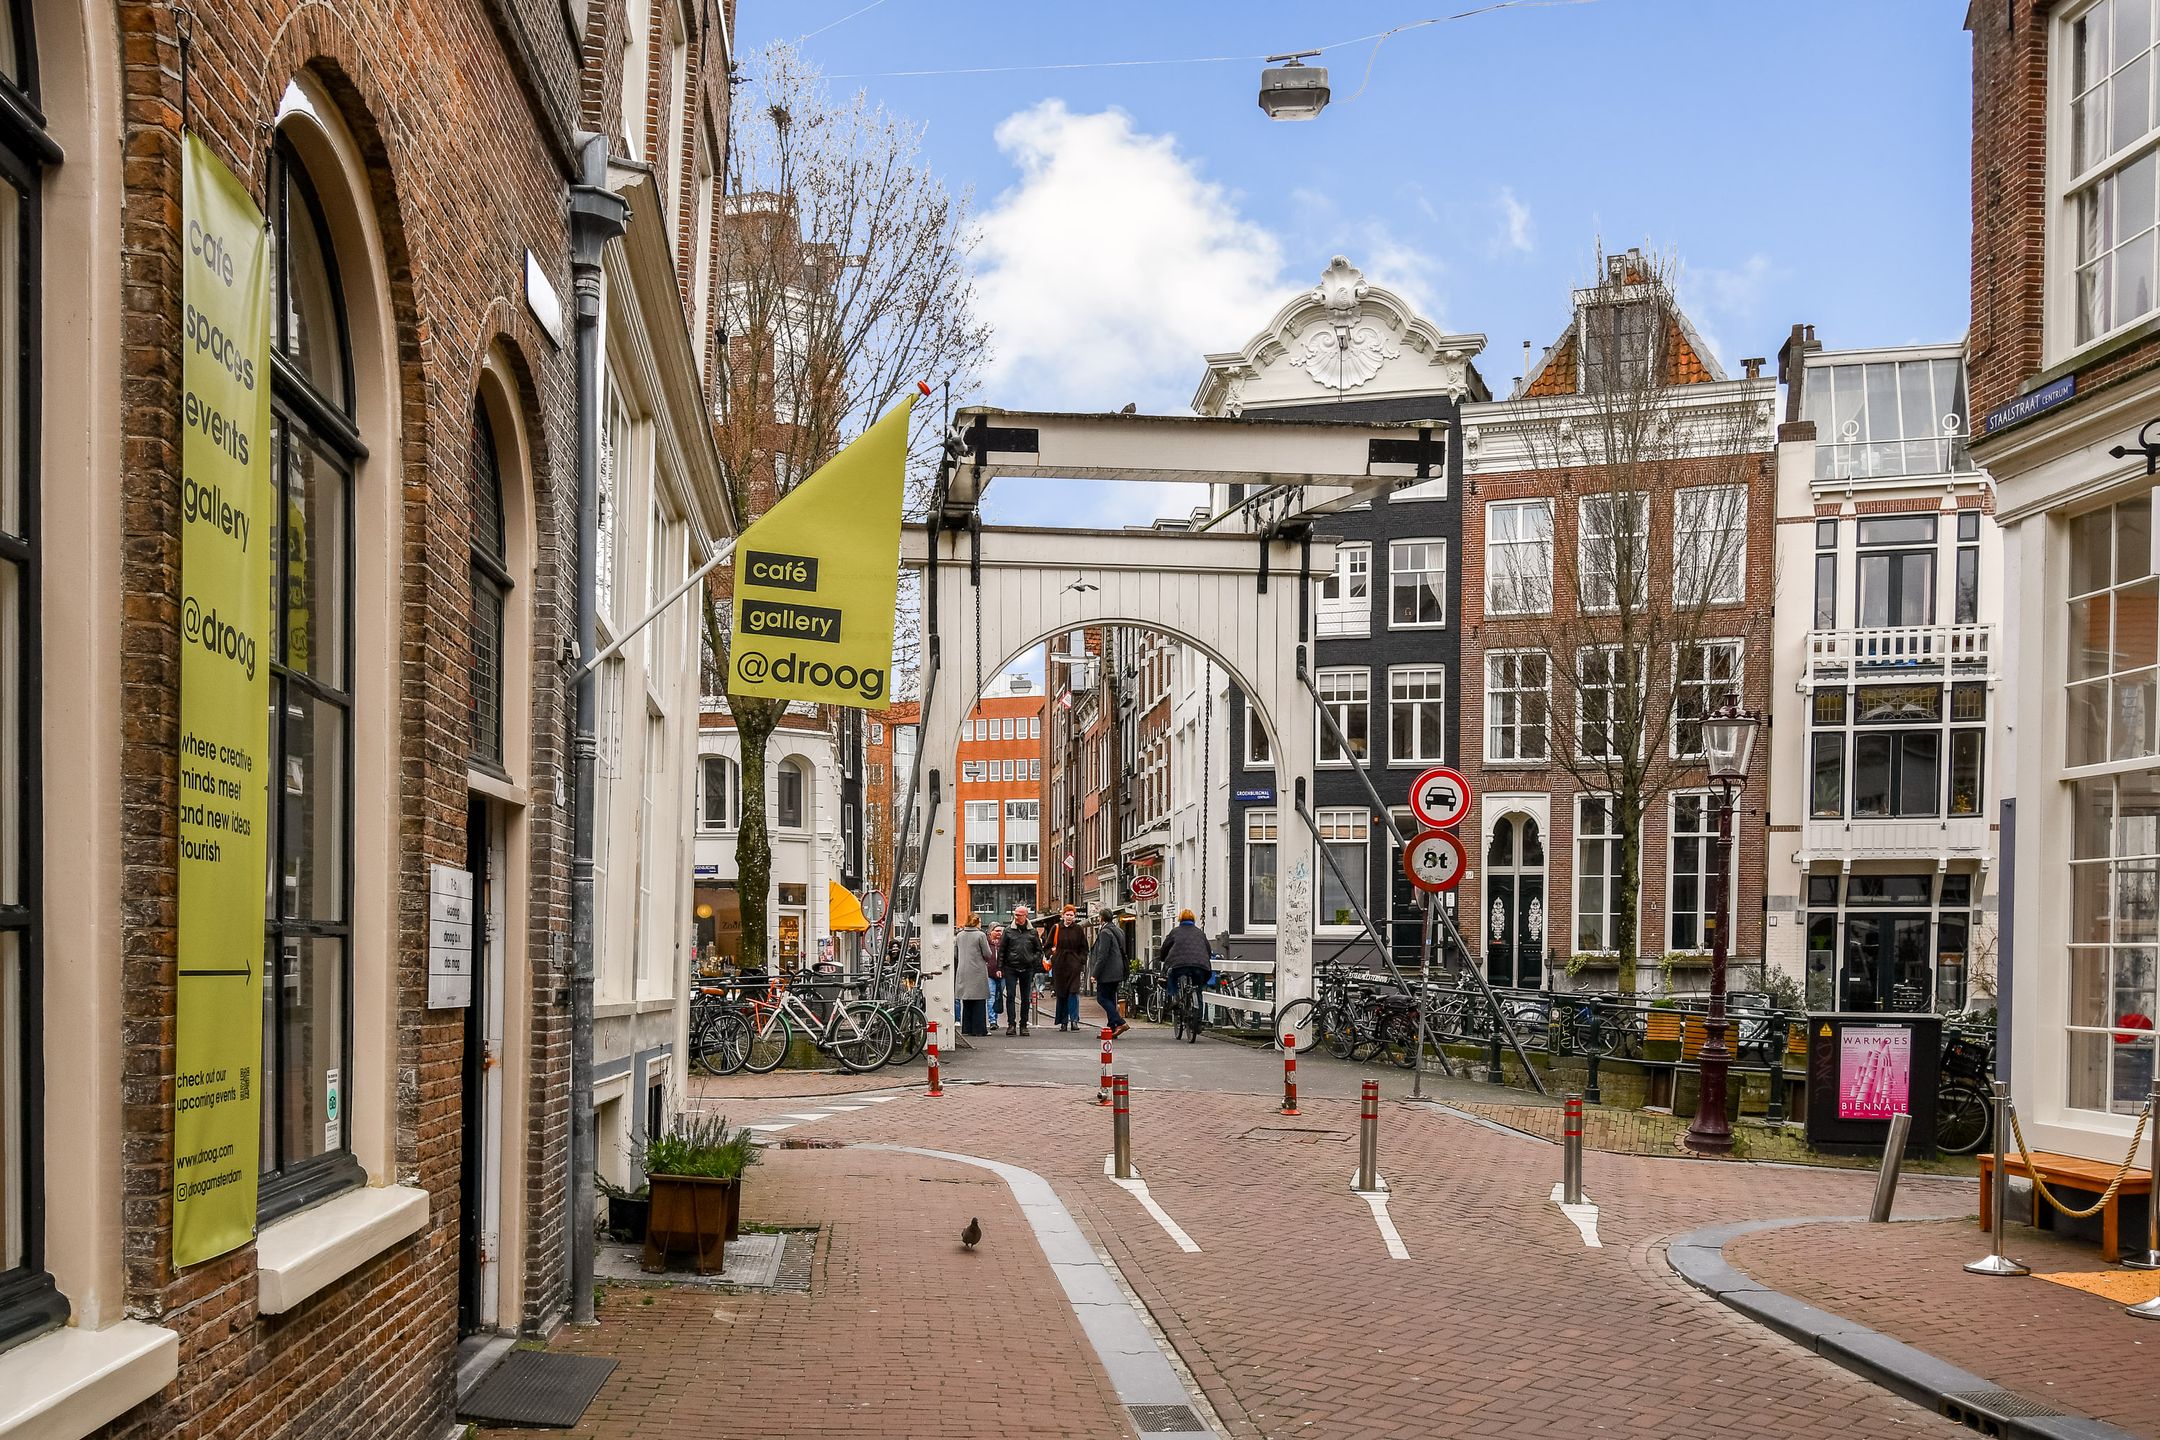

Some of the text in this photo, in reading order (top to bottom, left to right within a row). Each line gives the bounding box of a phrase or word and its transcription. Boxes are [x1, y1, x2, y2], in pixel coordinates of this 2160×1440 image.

[187, 303, 254, 391] spaces
[1989, 387, 2069, 431] STAALSTRAAT CENTRUM
[185, 391, 249, 466] events
[184, 477, 250, 553] gallery
[752, 561, 808, 583] café
[749, 609, 834, 637] gallery
[183, 596, 256, 682] @droog
[737, 651, 884, 700] @droog
[219, 745, 252, 773] creative
[218, 777, 242, 801] meet
[206, 810, 230, 830] new
[231, 811, 251, 836] ideas
[1423, 851, 1449, 869] 8t
[1843, 1037, 1908, 1045] WARMOES
[176, 1068, 227, 1089] check out our
[176, 1086, 236, 1114] upcoming events
[1841, 1102, 1907, 1111] BIENNALE
[176, 1143, 234, 1170] www.droog.com
[187, 1169, 242, 1197] droogamsterdam
